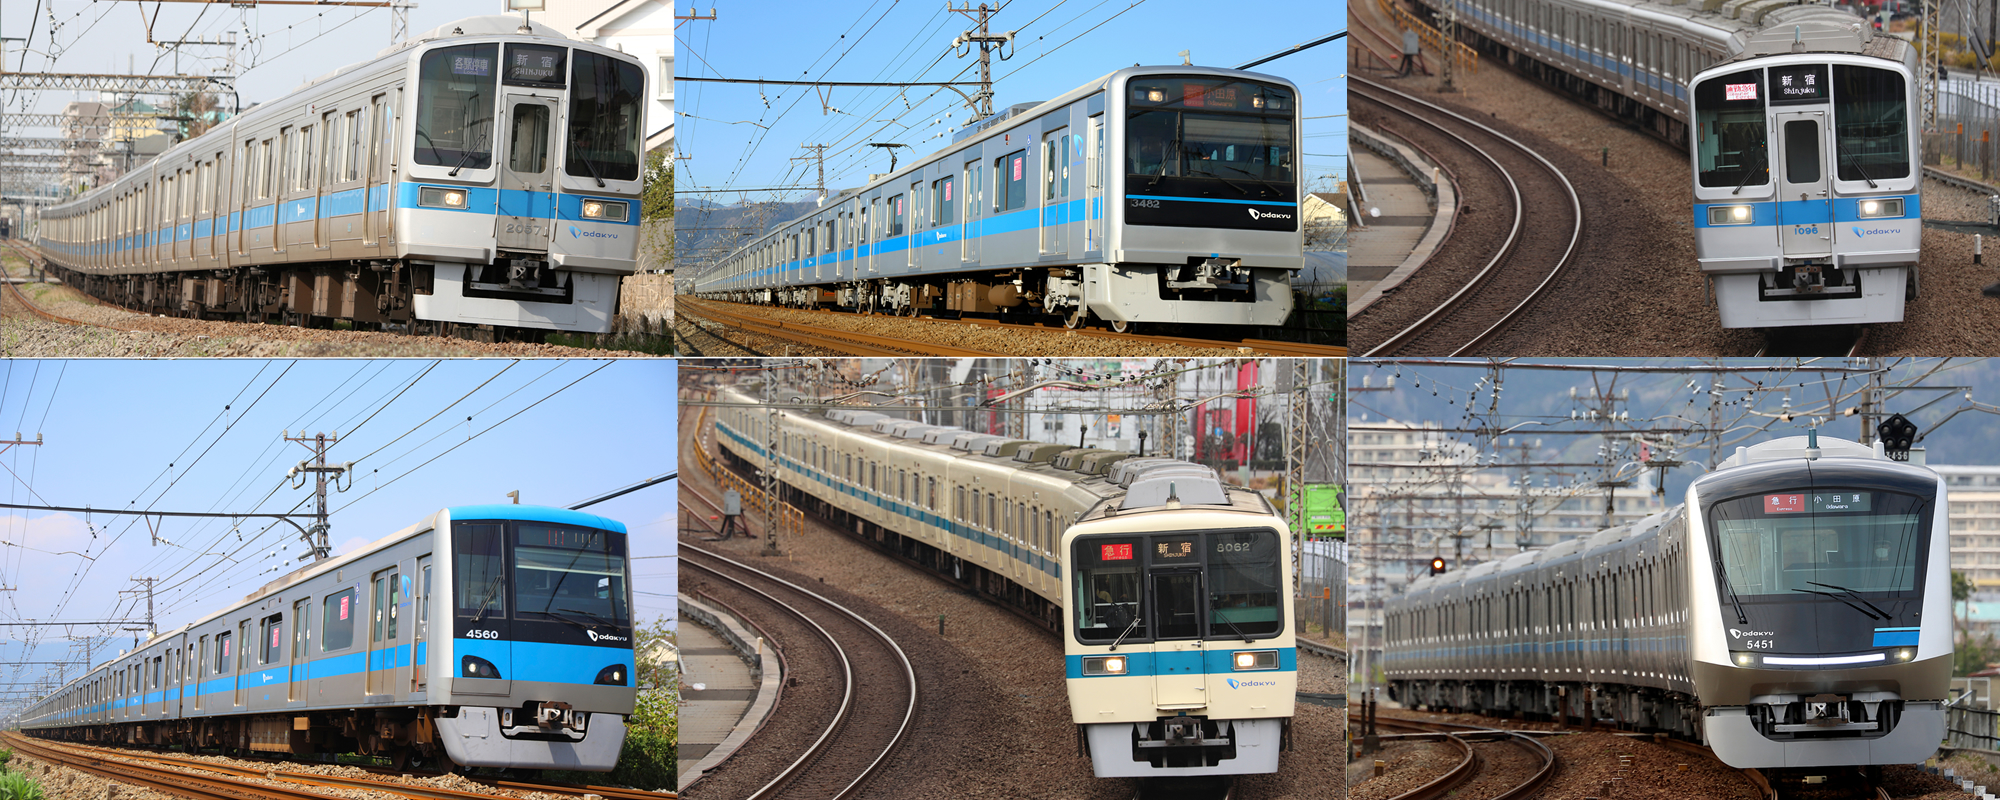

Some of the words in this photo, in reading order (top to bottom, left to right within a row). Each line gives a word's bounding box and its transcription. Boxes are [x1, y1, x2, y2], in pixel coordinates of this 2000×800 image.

[516, 54, 553, 68] 新宿
[515, 68, 553, 77] SHINJUKU
[1781, 74, 1816, 86] 新宿
[1204, 88, 1236, 100] 小田原
[1783, 87, 1815, 96] Shinjuku
[1131, 199, 1161, 209] 3482
[506, 223, 542, 235] 2057
[1794, 227, 1819, 235] 1096
[583, 231, 619, 239] odakyu
[1771, 496, 1798, 505] 急行
[1813, 494, 1861, 504] 小田原
[1104, 545, 1130, 556] 急行
[1158, 542, 1192, 555] 新宿
[1216, 542, 1250, 553] 8062
[466, 629, 499, 639] 4560
[599, 634, 628, 642] odakyu
[1746, 640, 1773, 649] 5451
